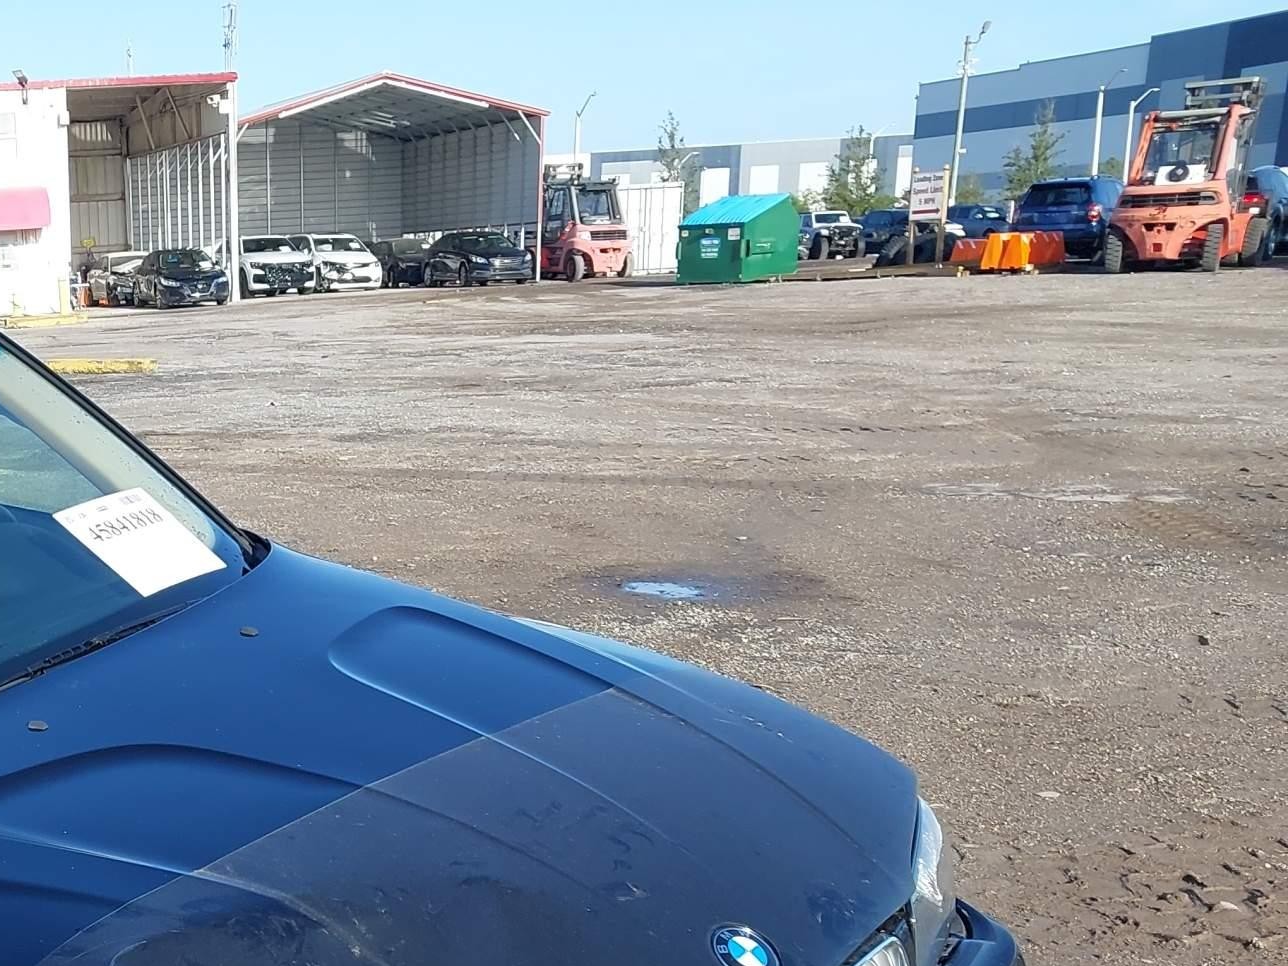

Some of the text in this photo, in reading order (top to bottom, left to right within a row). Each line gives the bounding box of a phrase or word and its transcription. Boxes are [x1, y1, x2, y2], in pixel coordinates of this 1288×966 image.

[913, 175, 932, 183] Loading
[912, 185, 944, 195] Speed Limit
[924, 197, 936, 205] MPH
[89, 508, 164, 541] 45841818
